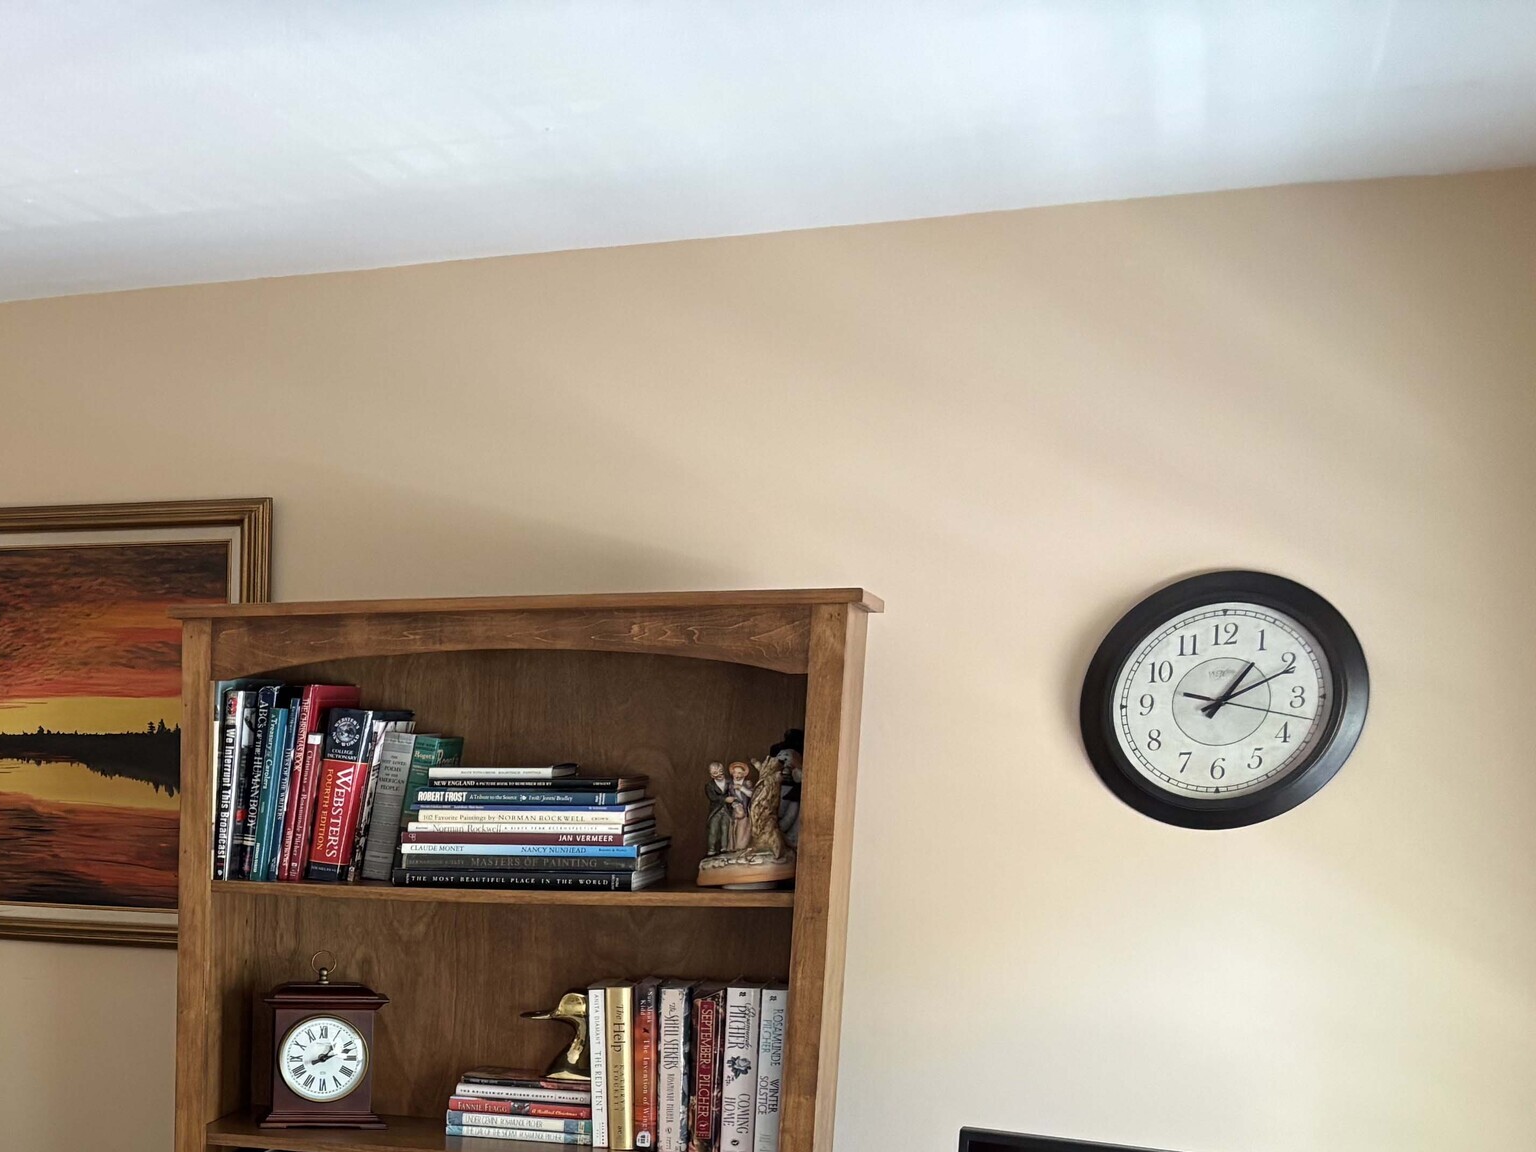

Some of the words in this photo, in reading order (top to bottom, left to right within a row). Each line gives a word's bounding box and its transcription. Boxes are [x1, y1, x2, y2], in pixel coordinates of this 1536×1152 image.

[1177, 633, 1199, 656] 11
[1211, 622, 1239, 646] 12
[1258, 629, 1267, 651] 1
[1148, 660, 1174, 683] 10
[1281, 652, 1297, 674] 2
[1139, 693, 1154, 716] 9
[1289, 685, 1306, 708] 3
[225, 728, 236, 744] We
[1147, 729, 1162, 752] 8
[1275, 721, 1291, 744] 4
[222, 745, 235, 787] Interrupt
[327, 753, 357, 761] DICTIONARY
[1178, 752, 1192, 773] 7
[1210, 757, 1226, 780] 6
[1247, 747, 1264, 770] 5
[250, 757, 262, 798] HUMAN
[323, 769, 334, 808] FOURTH
[220, 789, 231, 809] This
[418, 791, 444, 802] ROBERT
[445, 791, 467, 802] FROST
[247, 800, 258, 828] BODY
[325, 766, 355, 858] WEBSTER'S
[217, 812, 230, 858] Broadcast
[316, 811, 328, 851] EDITION
[432, 824, 464, 832] Norman
[467, 824, 502, 833] Rockwell
[471, 857, 520, 866] MASTERS
[524, 858, 538, 866] OF
[544, 859, 597, 868] PAINTING
[593, 994, 601, 1012] ANITA
[615, 1004, 624, 1020] The
[664, 1015, 679, 1036] SHELL
[728, 1004, 746, 1050] PILCHER
[761, 1020, 772, 1053] PILCHER
[294, 1040, 306, 1051] X
[611, 1022, 626, 1053] Help
[699, 1009, 713, 1066] SEPTEMBER
[770, 1008, 784, 1067] ROSAMUNDE
[594, 1051, 602, 1068] THE
[663, 1039, 679, 1070] SEEKERS
[333, 1075, 342, 1088] V
[594, 1071, 603, 1088] RED
[595, 1090, 603, 1113] TENT
[697, 1074, 711, 1118] PILCHER
[758, 1075, 769, 1115] SOLSTICE
[768, 1079, 780, 1114] WINTER
[458, 1101, 484, 1111] FANNIE
[484, 1103, 508, 1113] FLAGG
[723, 1096, 736, 1127] HOME
[736, 1093, 751, 1134] COMING
